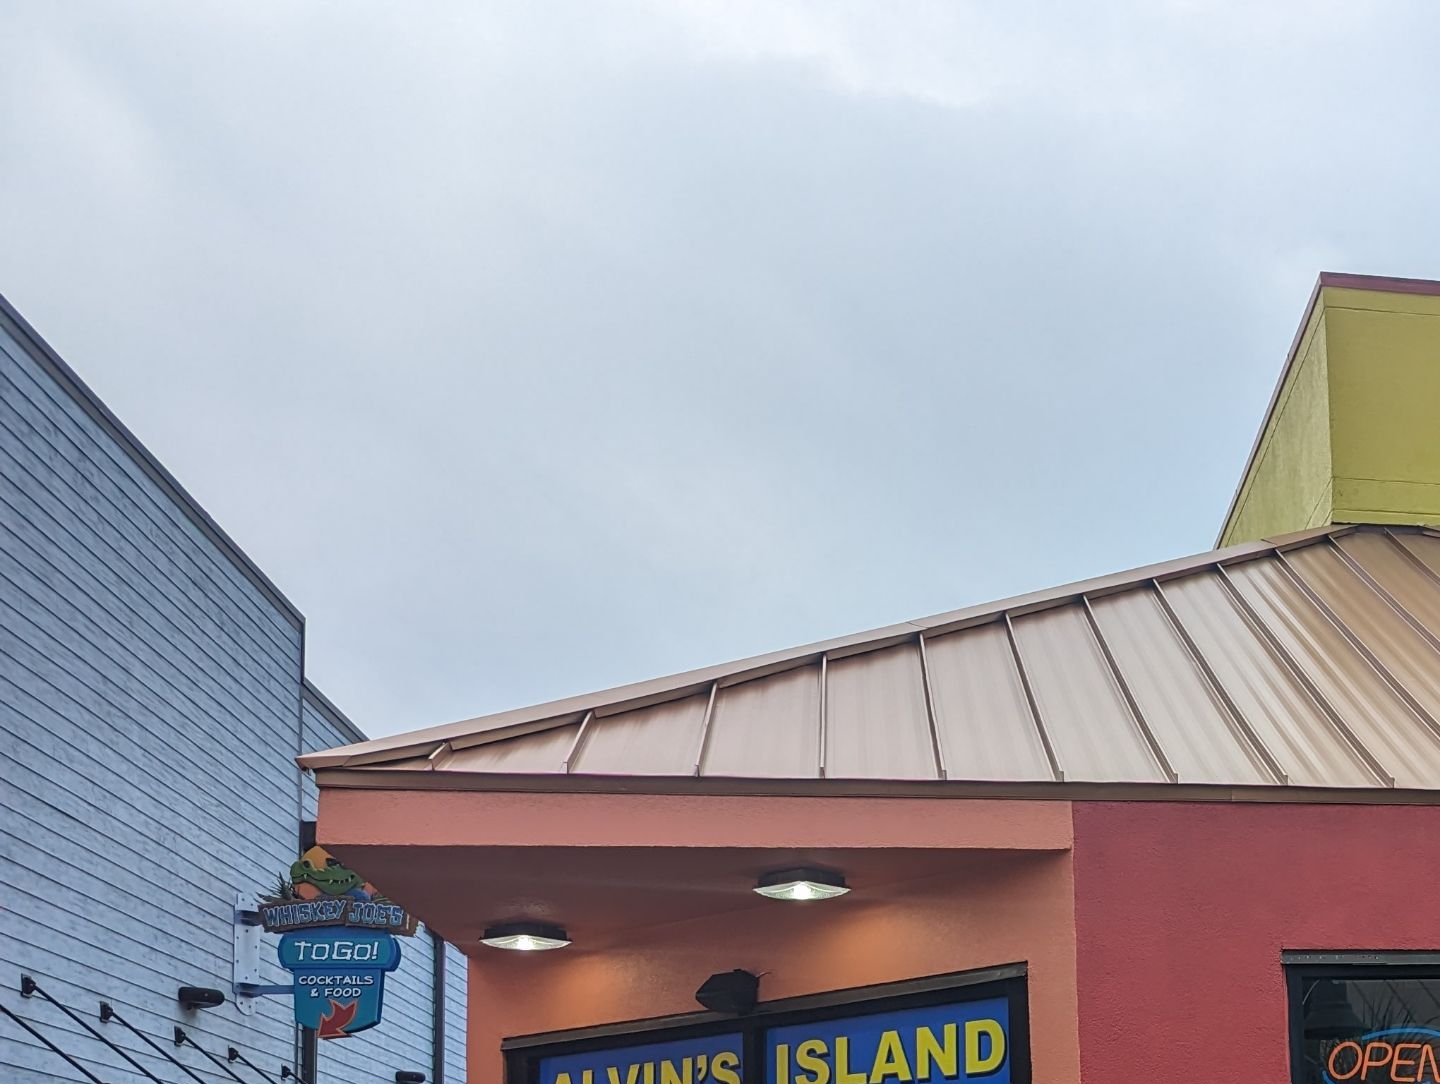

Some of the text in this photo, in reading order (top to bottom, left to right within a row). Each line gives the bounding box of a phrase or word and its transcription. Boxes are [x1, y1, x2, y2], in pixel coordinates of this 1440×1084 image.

[263, 900, 403, 926] WHISKEY JOE'S
[298, 975, 374, 985] COCKTAILS
[310, 988, 361, 997] & FOOD
